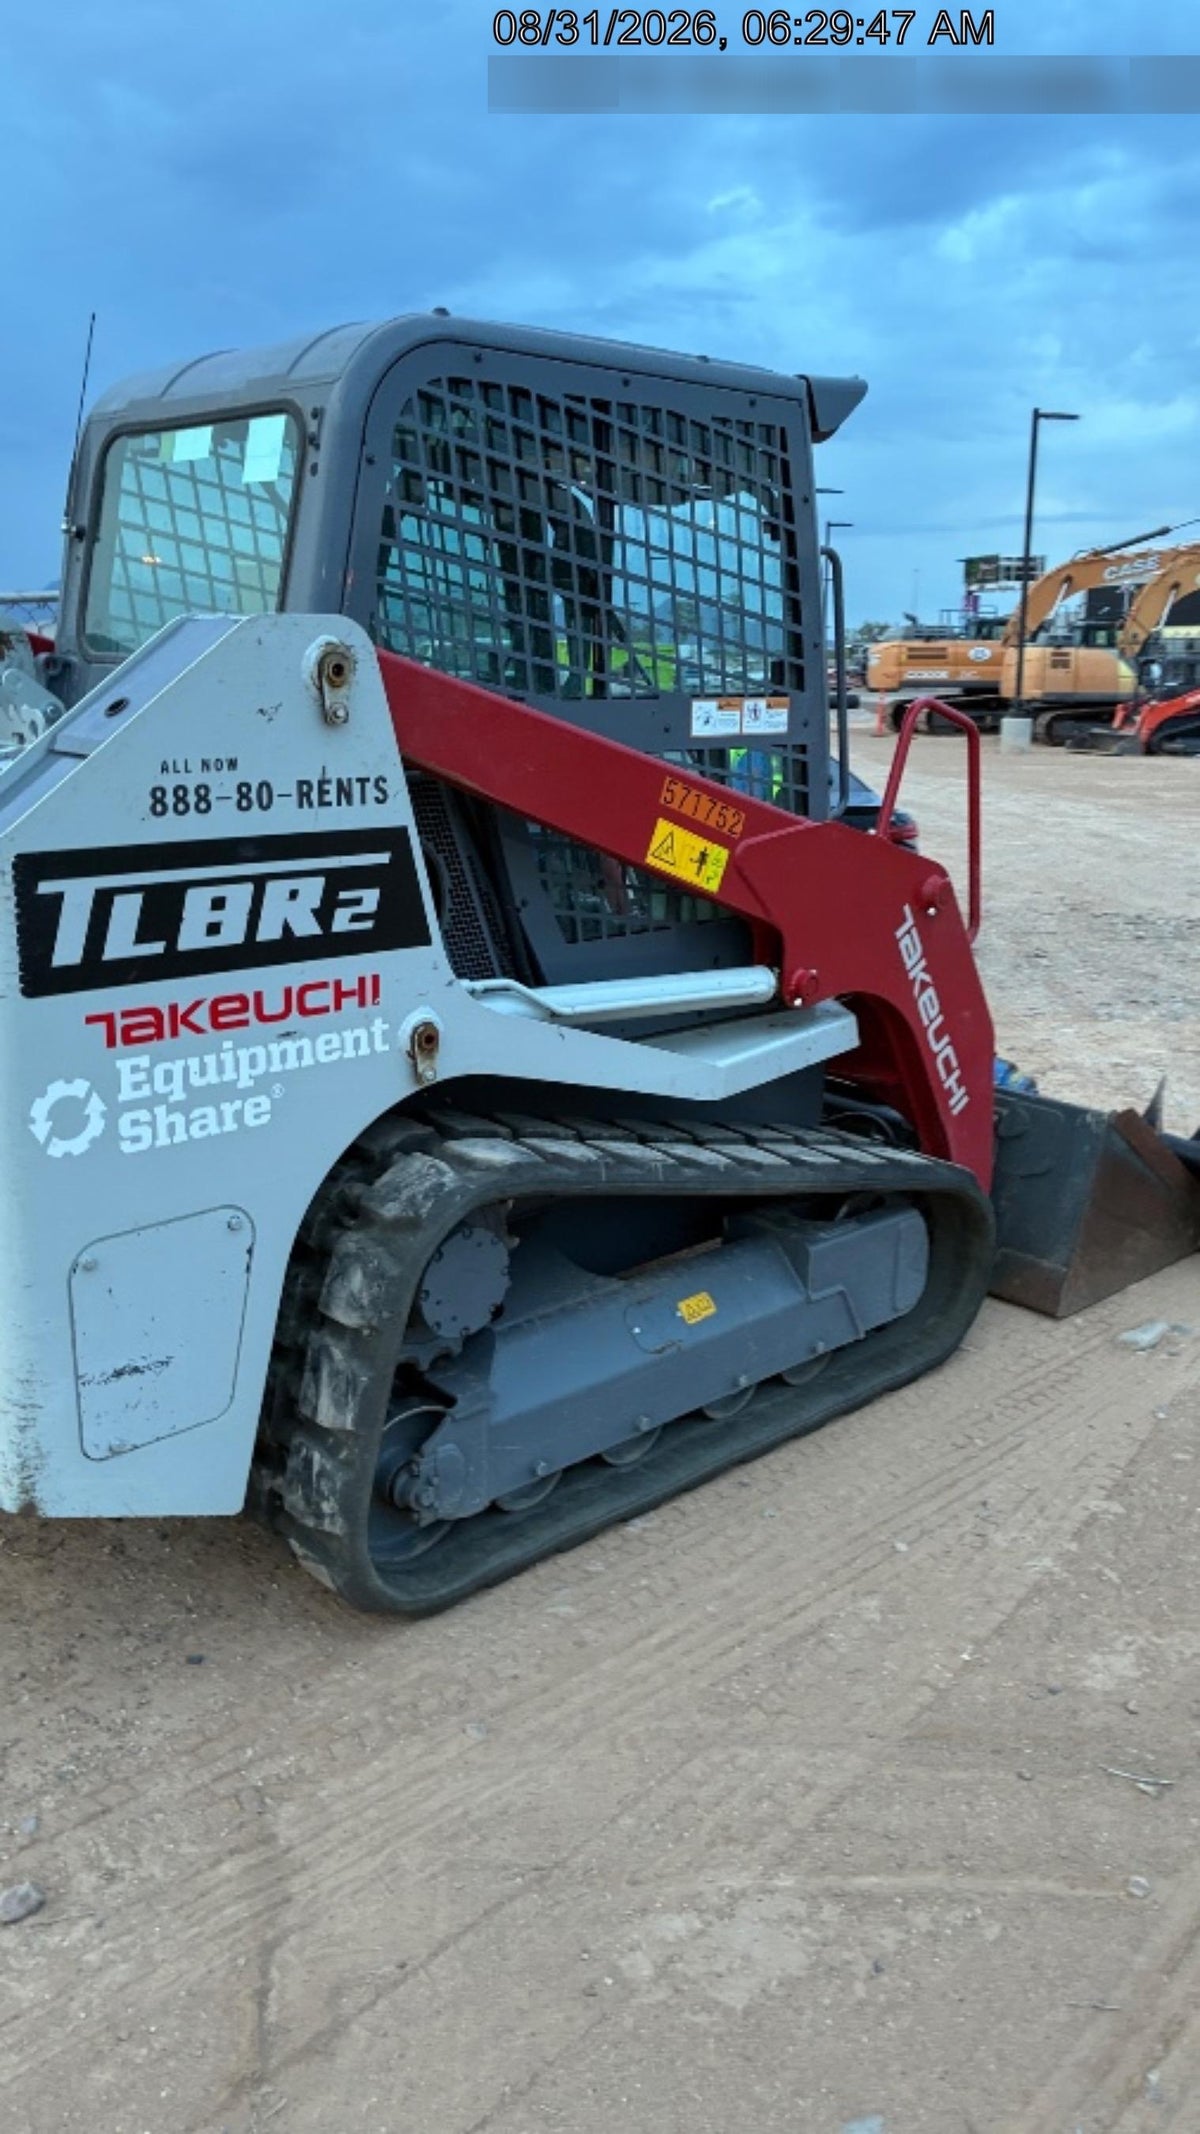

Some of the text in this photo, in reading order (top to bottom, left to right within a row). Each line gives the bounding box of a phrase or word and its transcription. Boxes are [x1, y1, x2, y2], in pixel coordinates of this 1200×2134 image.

[201, 757, 238, 773] NOW
[149, 777, 389, 817] 888-80-RENTS
[663, 779, 741, 835] 571752
[116, 1016, 391, 1104] Equipment
